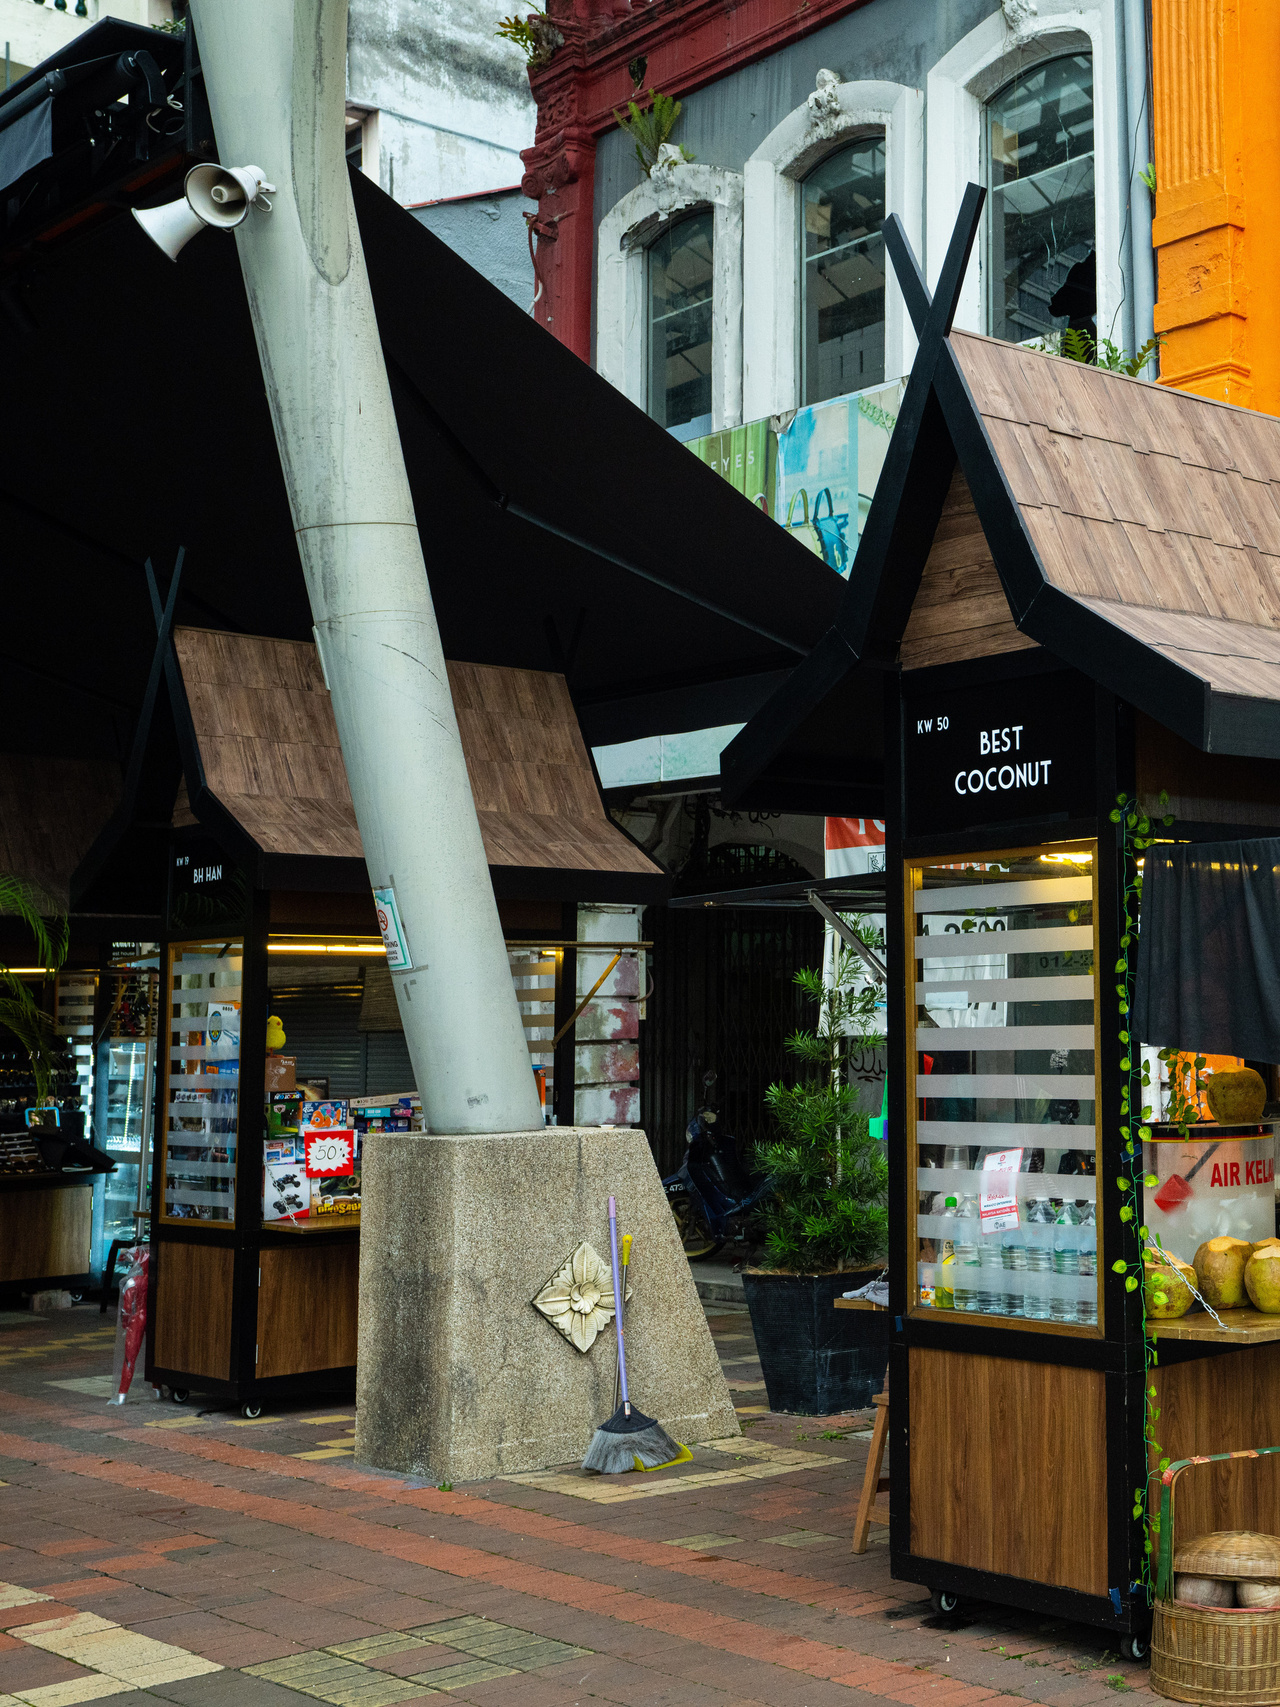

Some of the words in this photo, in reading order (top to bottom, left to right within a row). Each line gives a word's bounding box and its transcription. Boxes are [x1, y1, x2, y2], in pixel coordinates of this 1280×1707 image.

[917, 719, 932, 734] KW
[937, 716, 949, 731] 50
[980, 725, 1023, 755] BEST
[955, 760, 1052, 795] COCONUT
[193, 868, 204, 884] BH
[205, 865, 222, 882] HAN
[315, 1144, 346, 1161] 50%
[1210, 1162, 1241, 1188] AIR
